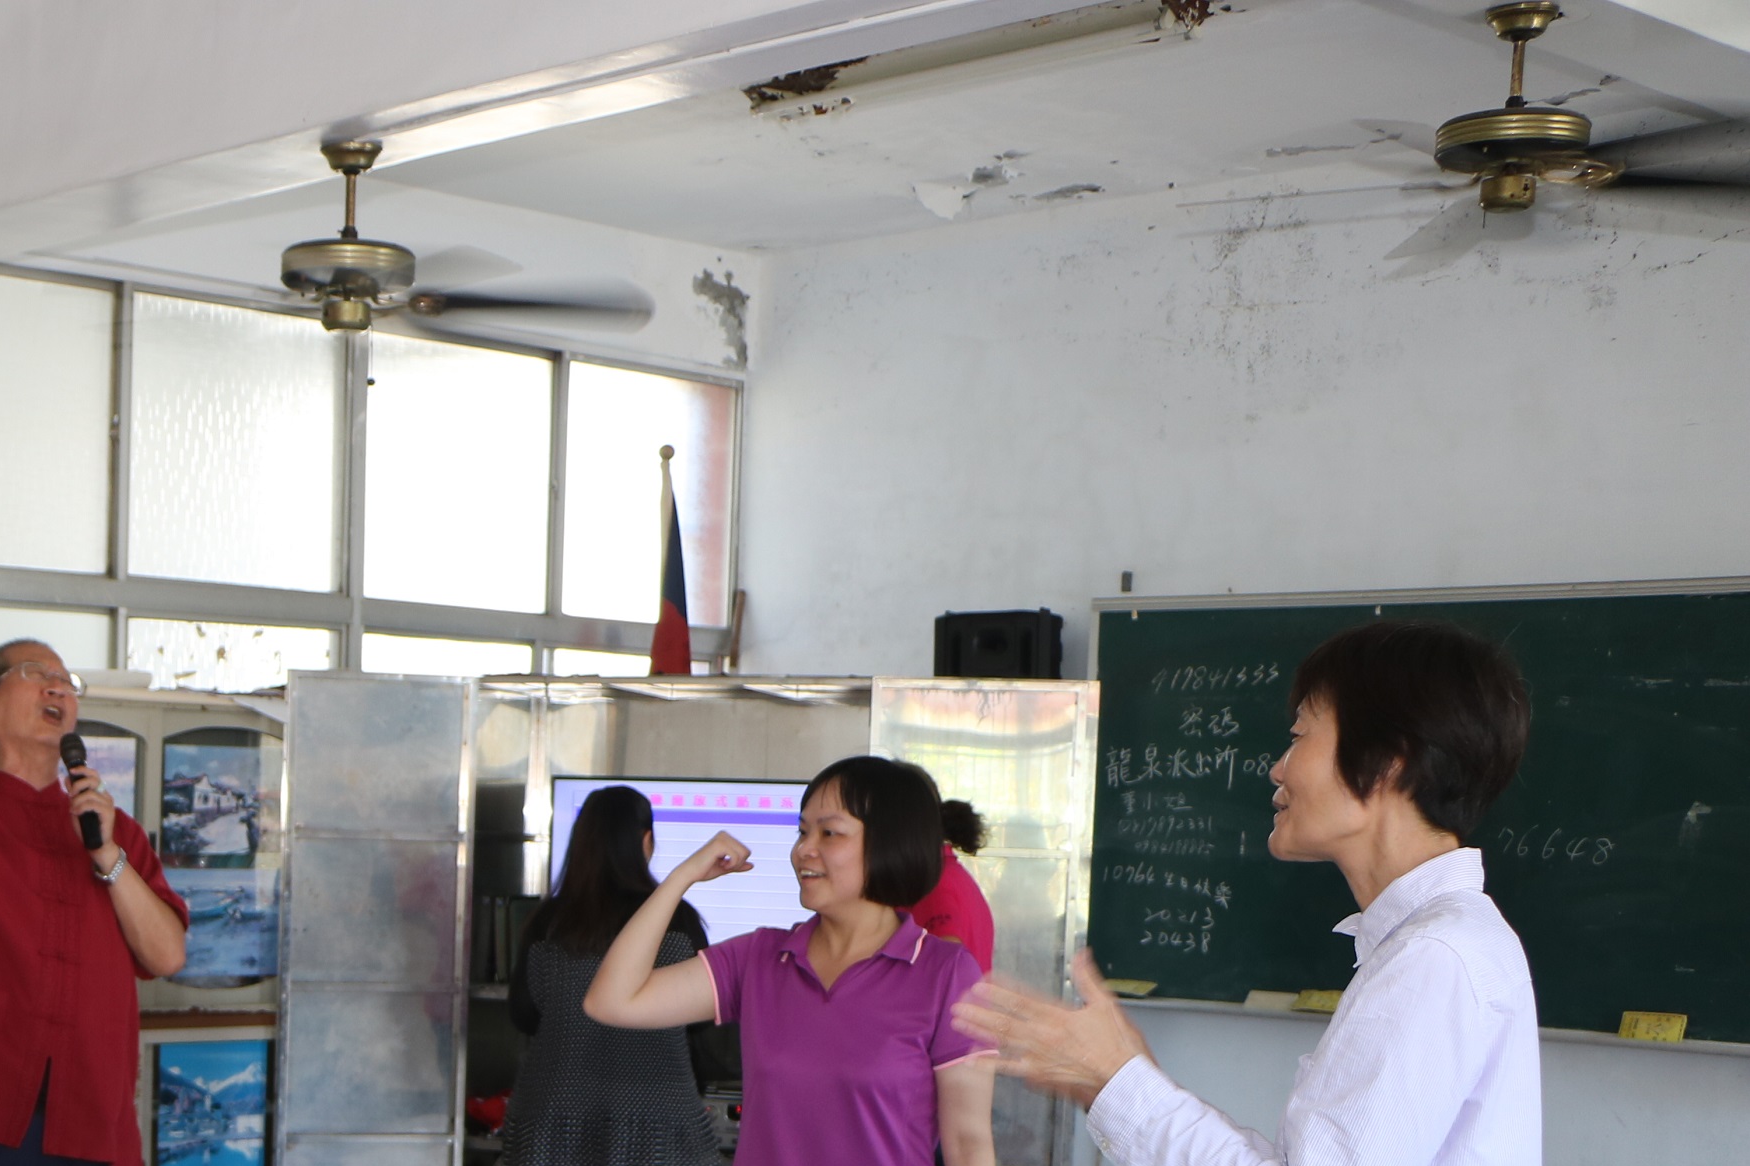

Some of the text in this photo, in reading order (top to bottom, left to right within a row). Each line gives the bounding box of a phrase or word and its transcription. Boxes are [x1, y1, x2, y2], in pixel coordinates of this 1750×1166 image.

[1106, 743, 1238, 790] 龍泉派出所
